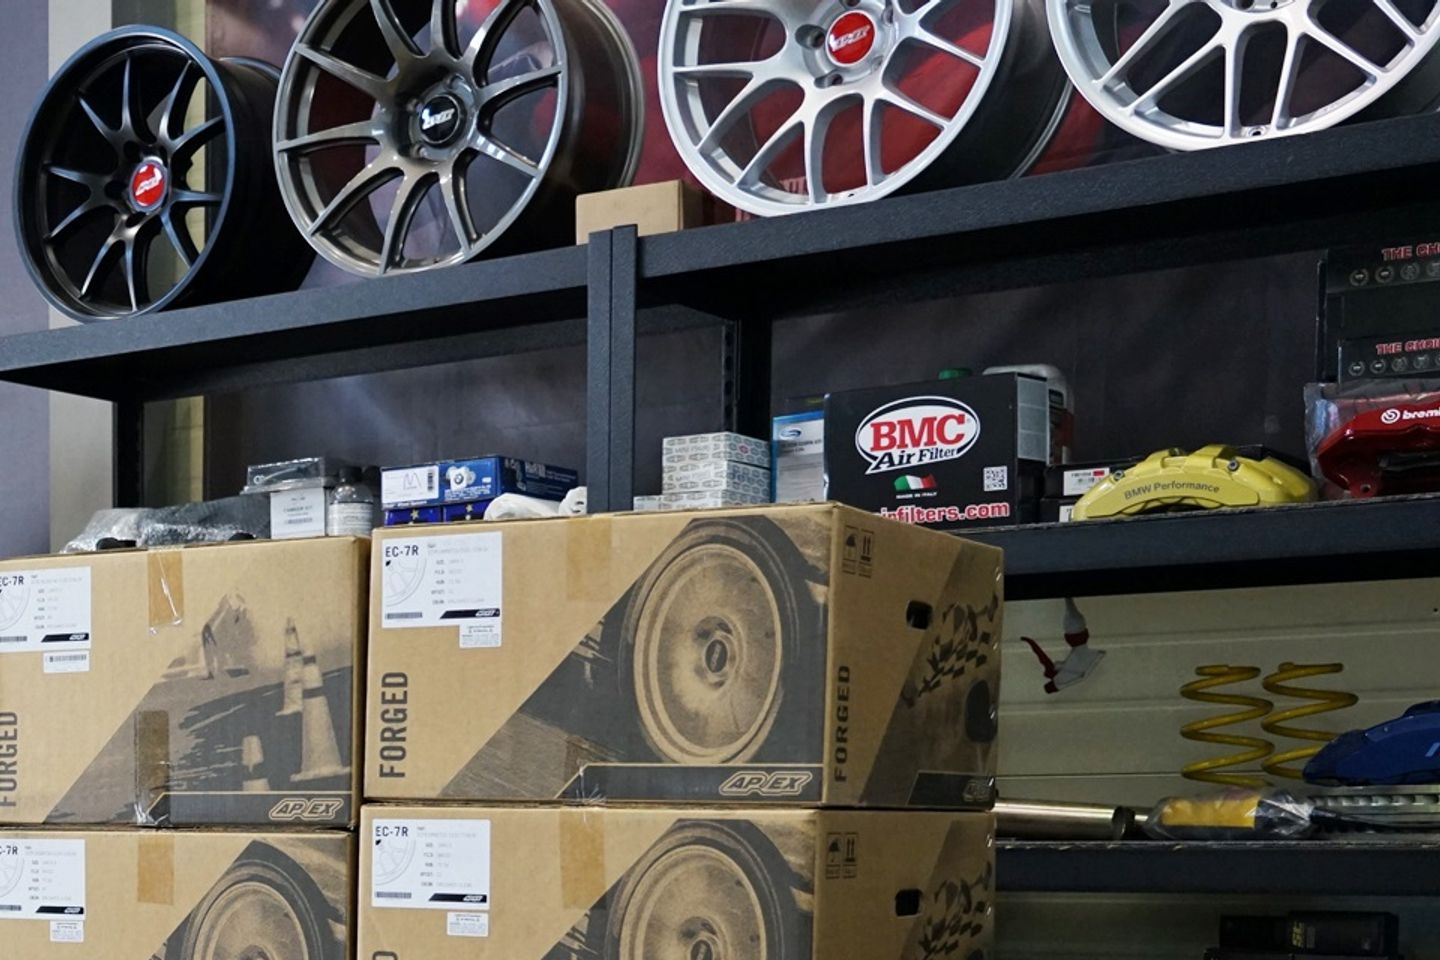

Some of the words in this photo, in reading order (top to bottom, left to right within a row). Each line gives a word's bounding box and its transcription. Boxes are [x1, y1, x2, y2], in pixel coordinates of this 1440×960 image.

[870, 414, 966, 452] BMC
[872, 451, 917, 470] Air
[1124, 484, 1152, 500] BMW
[1155, 479, 1221, 495] Performance
[385, 544, 419, 558] EC-7R
[379, 671, 408, 779] FORGED
[834, 664, 851, 783] FORGED
[376, 826, 409, 837] EC-7R
